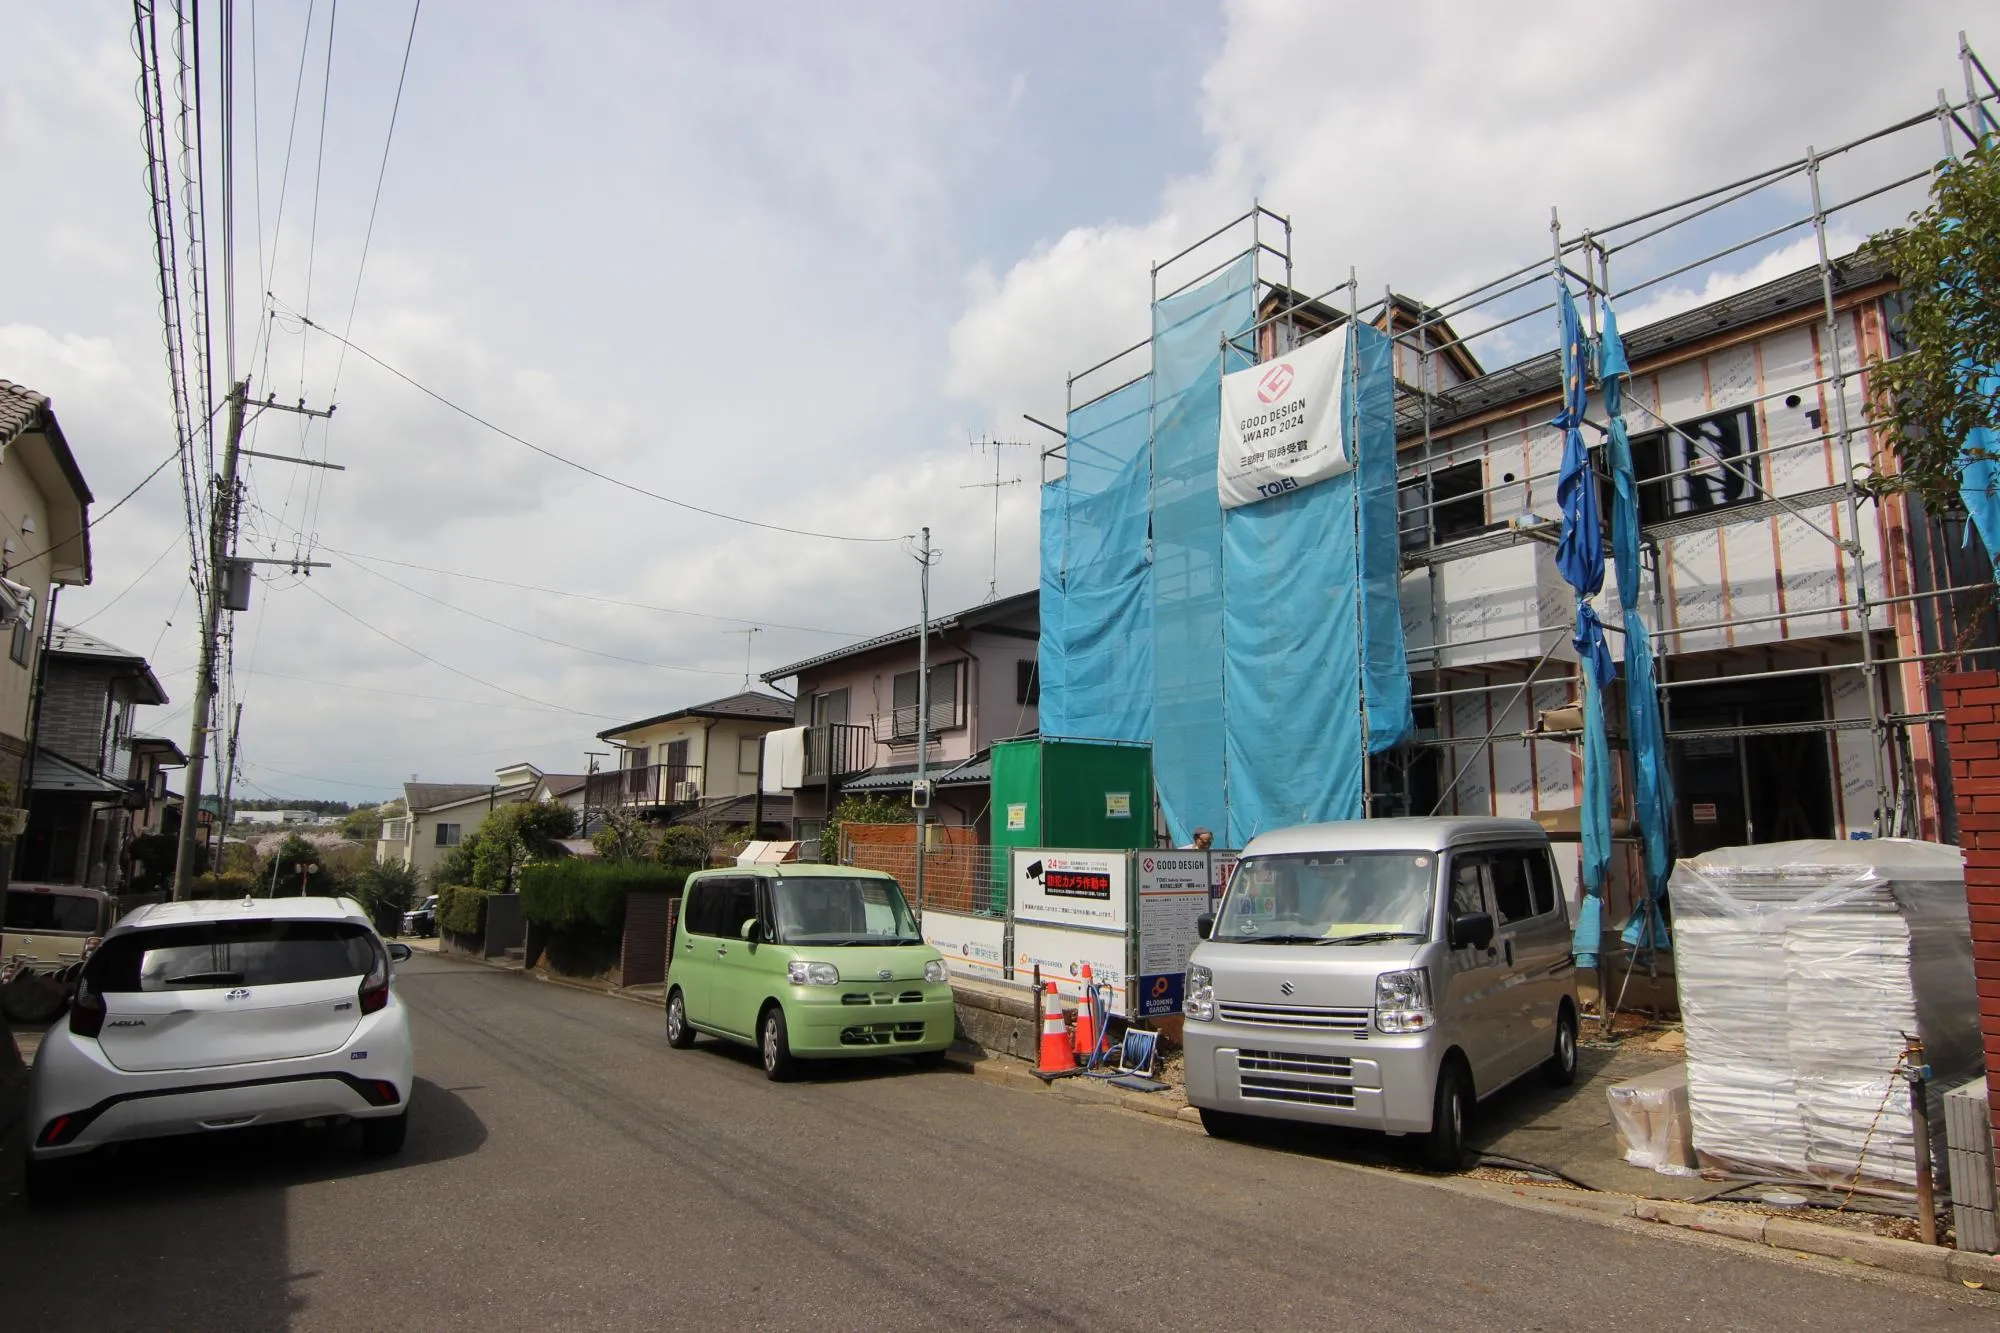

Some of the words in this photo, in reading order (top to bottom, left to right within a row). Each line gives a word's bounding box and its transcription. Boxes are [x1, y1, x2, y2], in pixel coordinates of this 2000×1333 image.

[1240, 415, 1267, 430] GOOD
[1270, 398, 1306, 422] DESIGN
[1242, 426, 1277, 445] AWARD
[1279, 414, 1304, 433] 2024
[1267, 439, 1308, 459] 同時受賞
[1048, 858, 1057, 869] 24
[1156, 860, 1177, 870] GOOD
[1179, 860, 1204, 870] DESIGN
